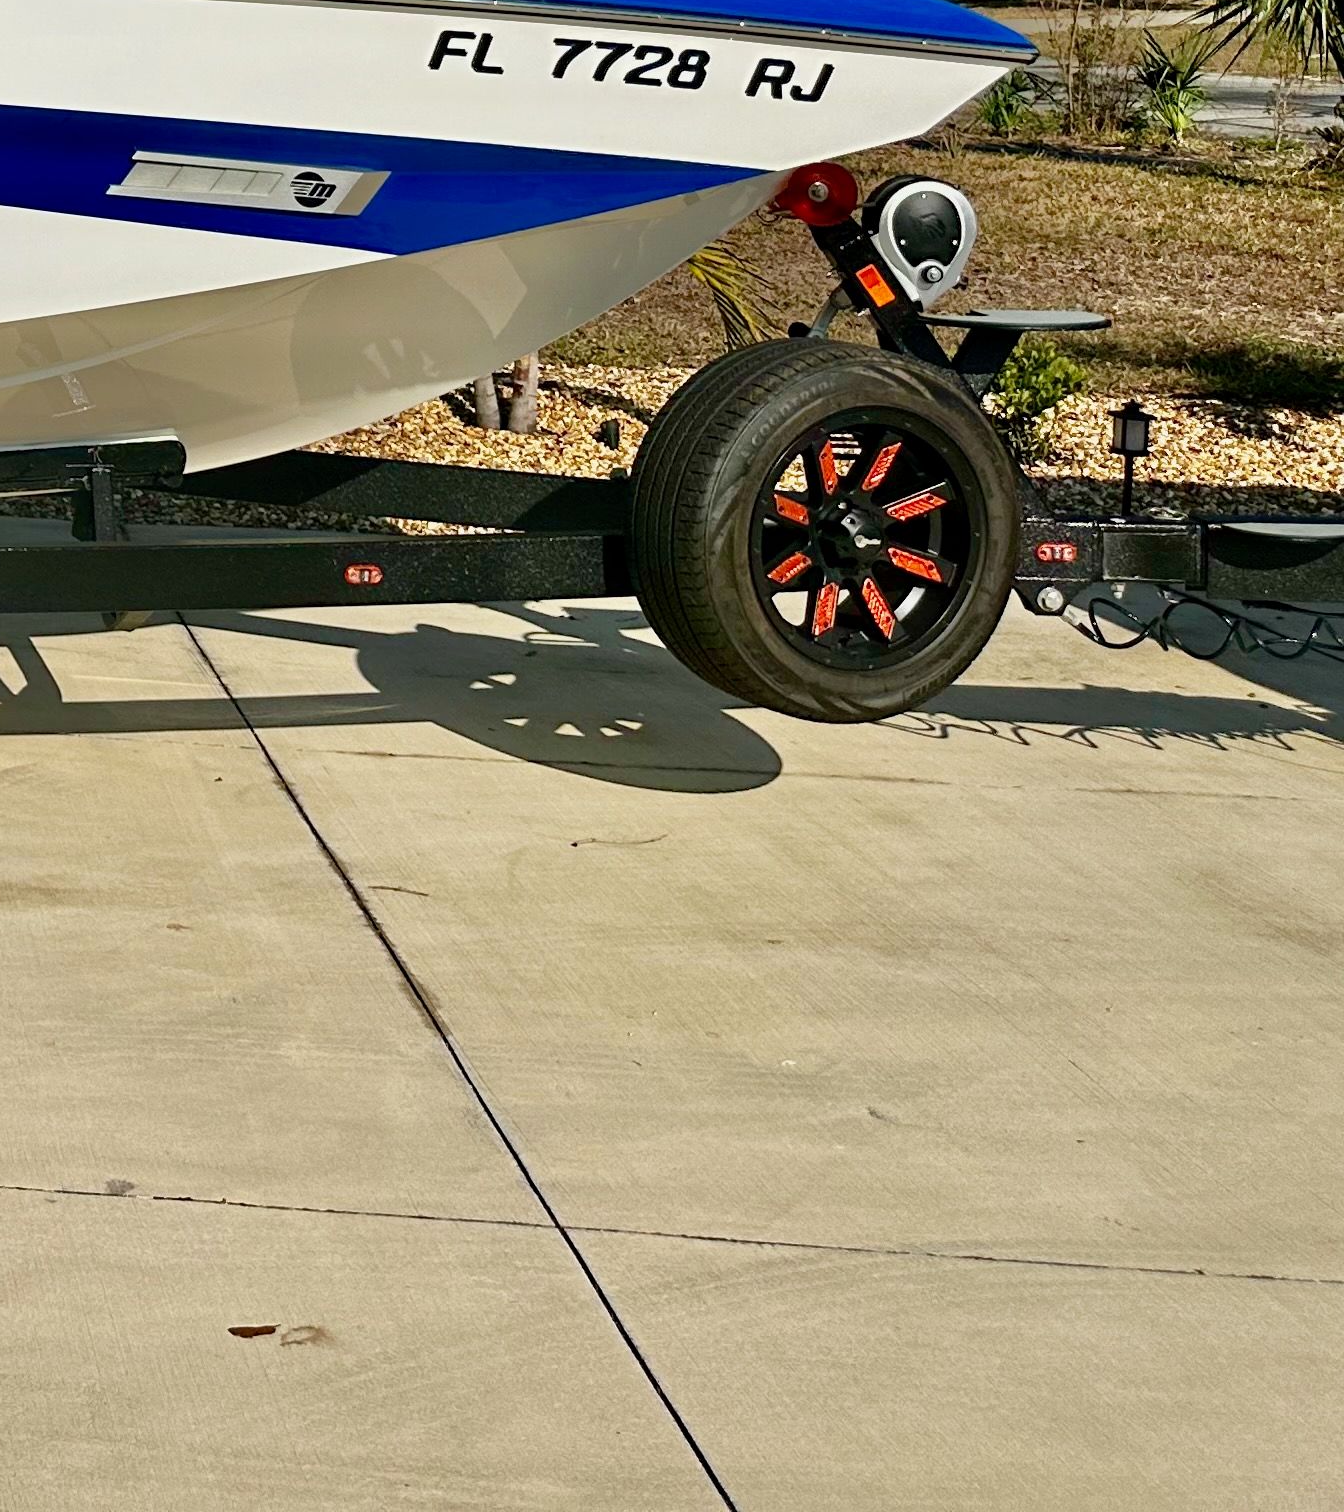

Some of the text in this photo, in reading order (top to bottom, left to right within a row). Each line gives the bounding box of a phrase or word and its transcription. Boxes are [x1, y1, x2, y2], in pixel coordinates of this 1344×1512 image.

[428, 29, 835, 103] FL 7728 RJ
